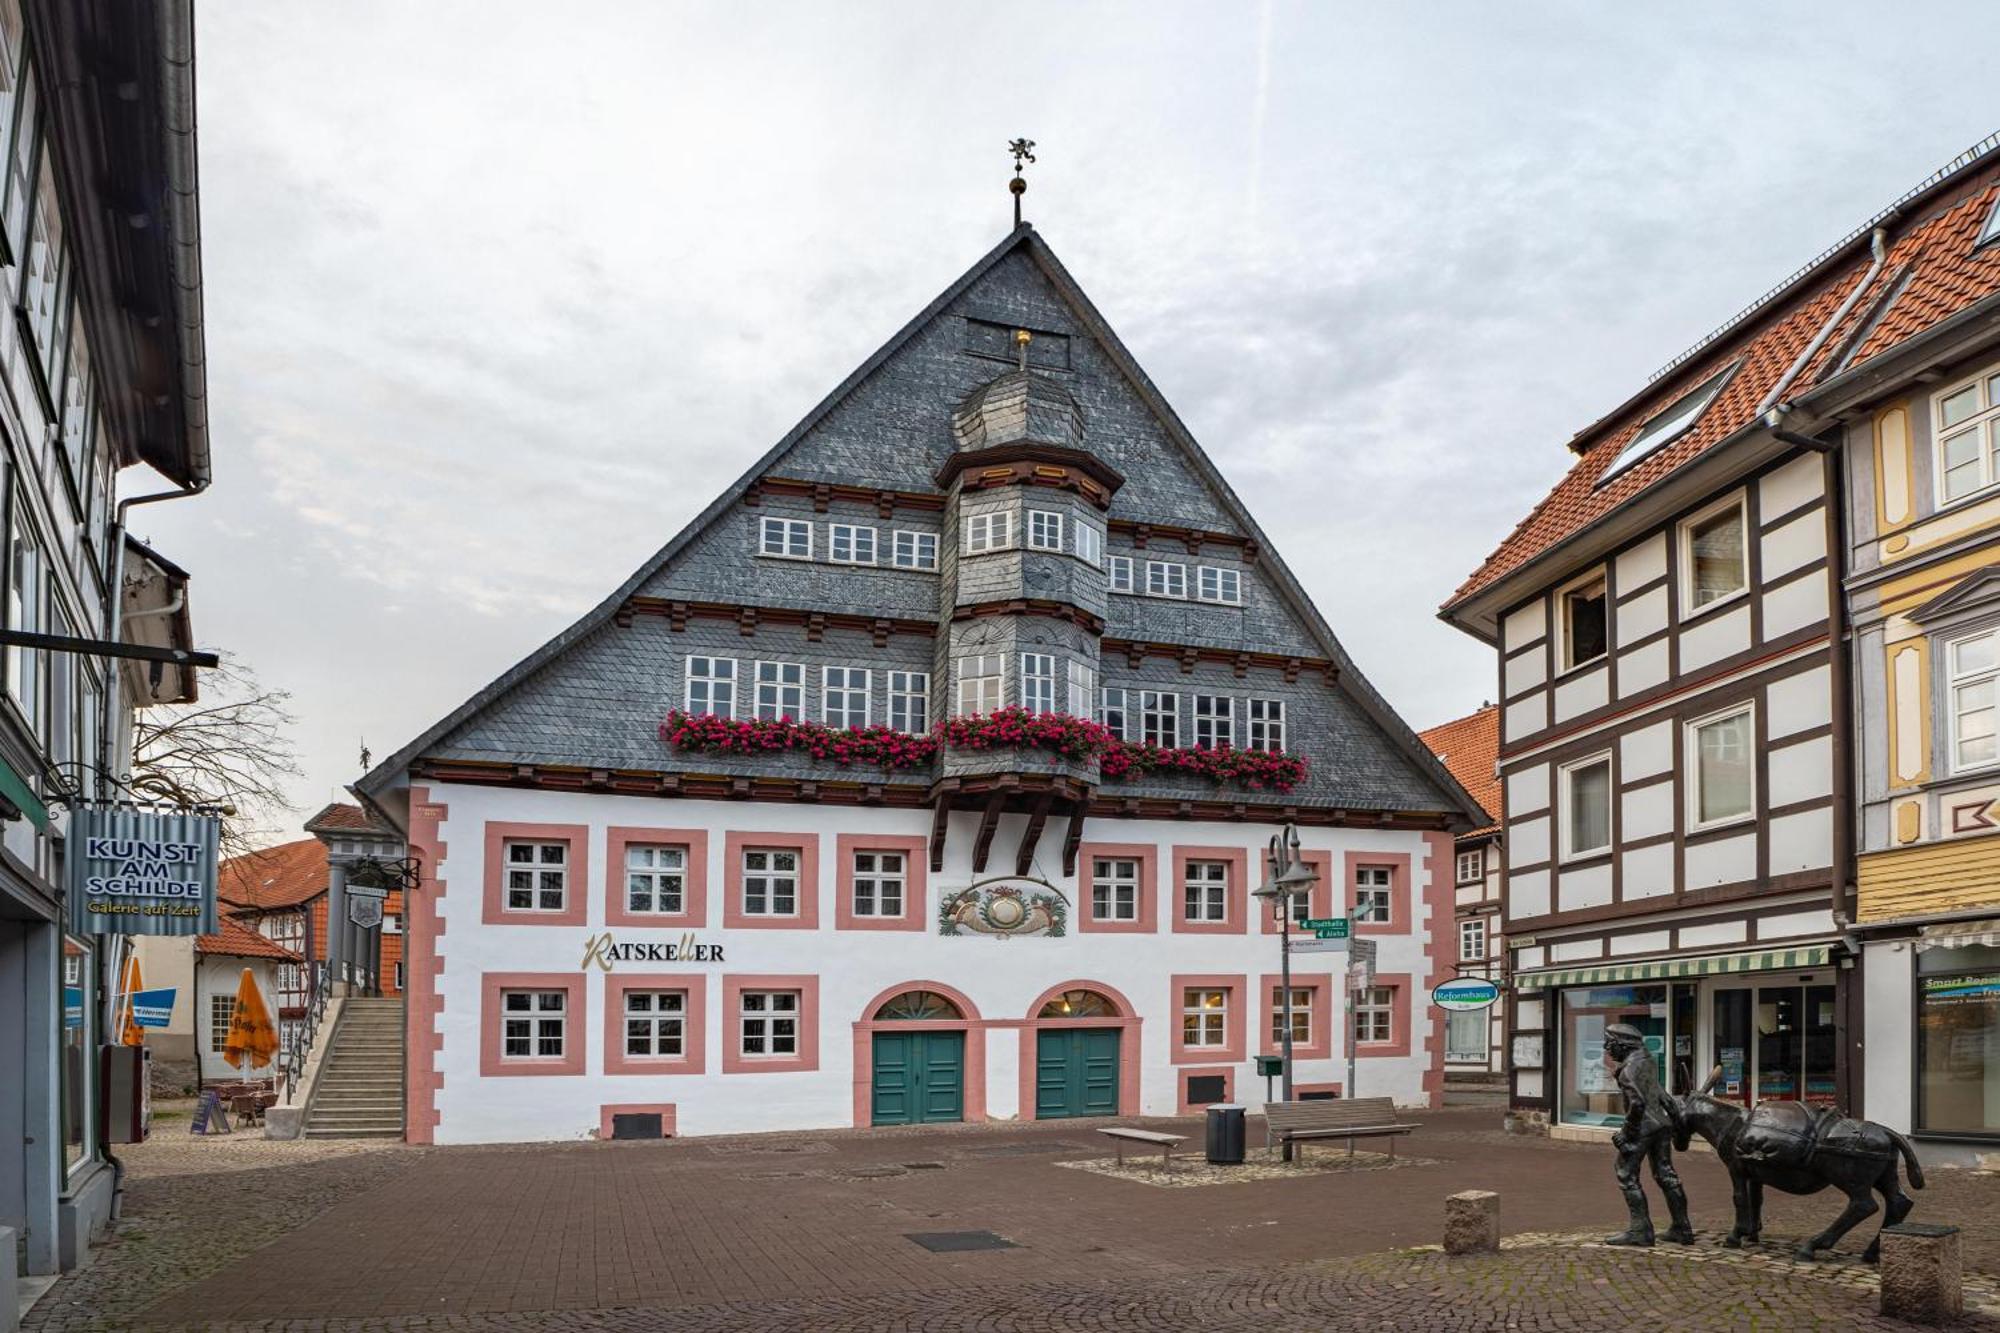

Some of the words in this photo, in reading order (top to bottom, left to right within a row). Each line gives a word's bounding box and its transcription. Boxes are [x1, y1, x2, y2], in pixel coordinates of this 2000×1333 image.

[86, 837, 202, 864] KUNST
[118, 860, 171, 879] AM
[86, 877, 202, 899] SCHILDE
[87, 900, 140, 915] Galerie
[144, 902, 169, 917] auf
[171, 903, 202, 917] Zeit
[1925, 978, 1962, 988] Smart
[1965, 976, 2000, 985] Repa
[1437, 990, 1491, 1001] Reformhaus
